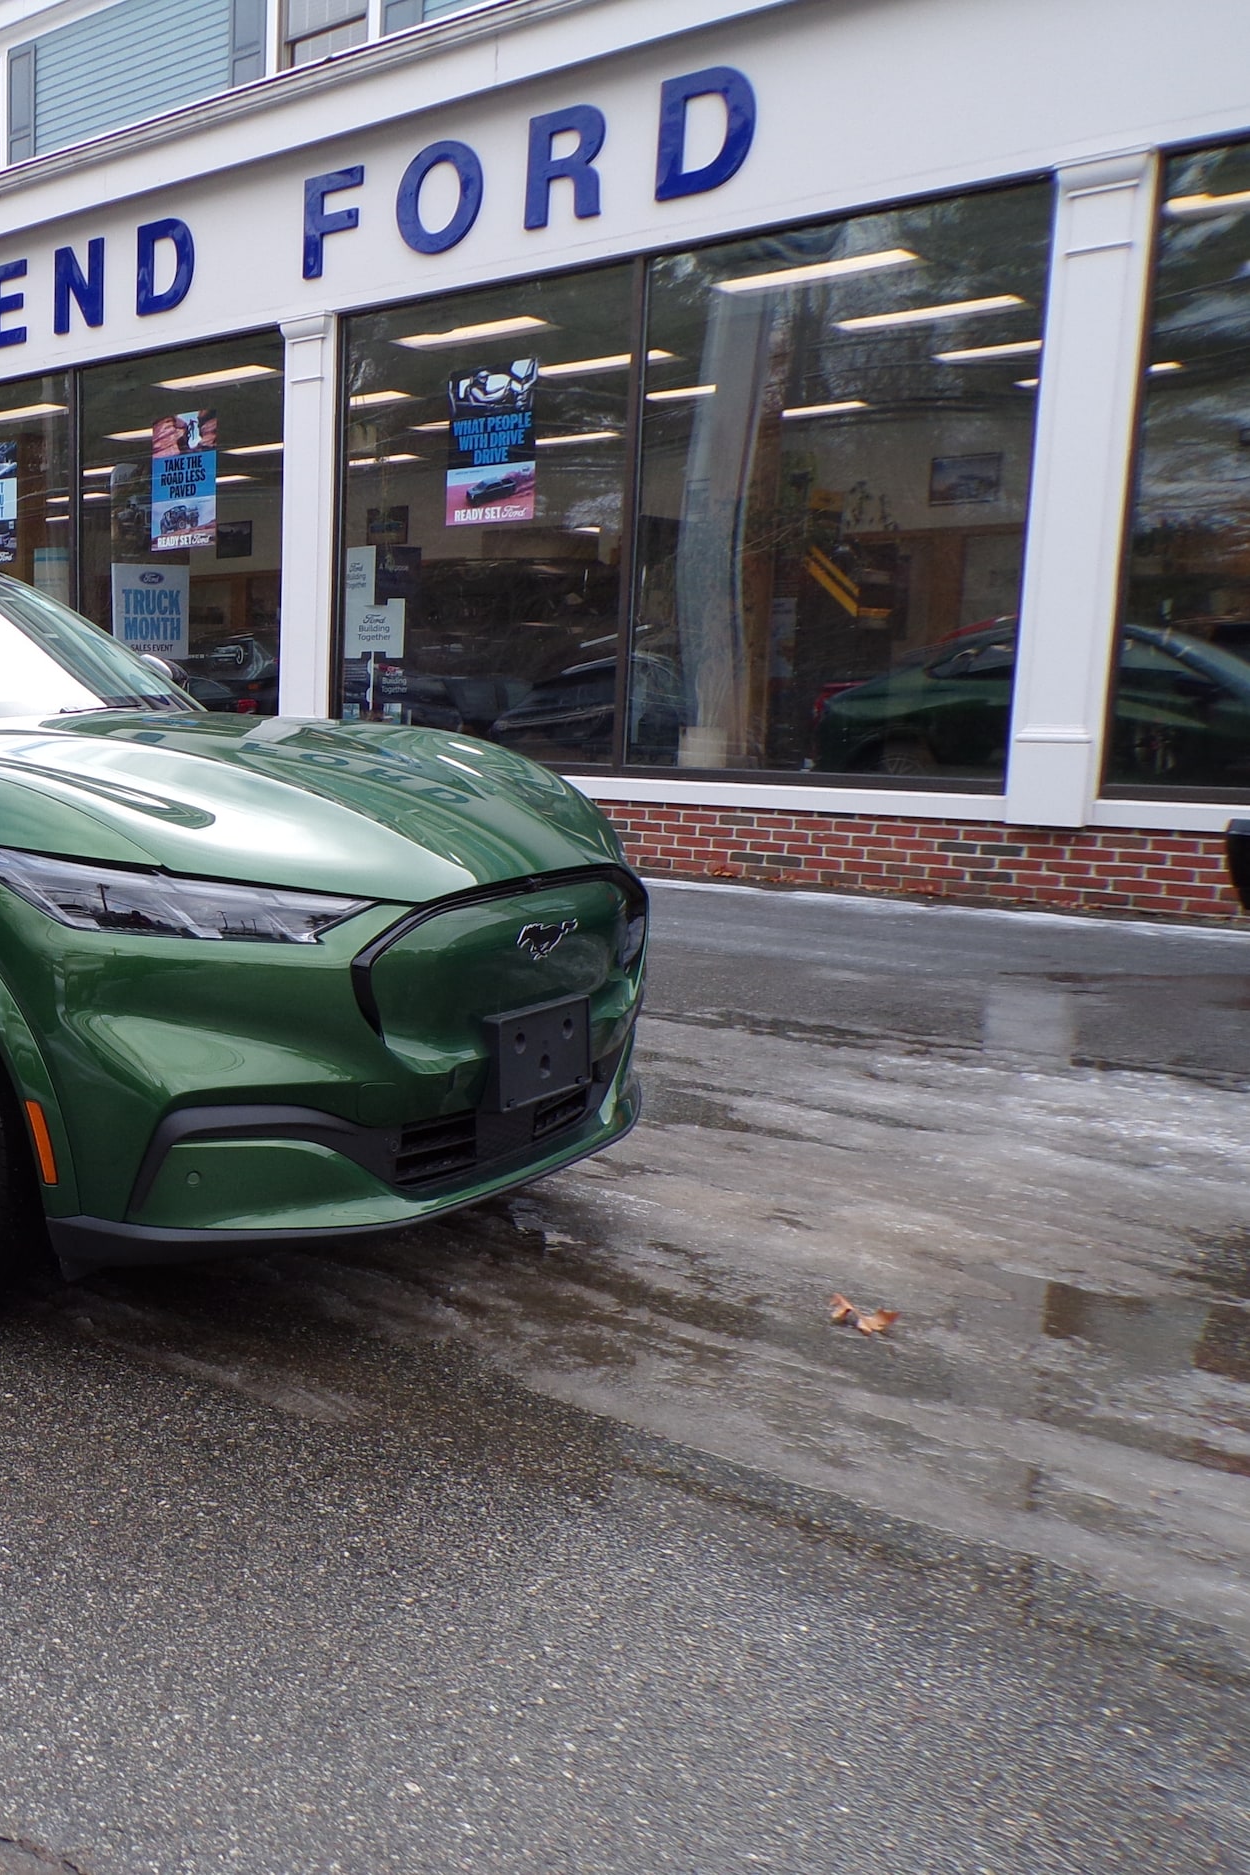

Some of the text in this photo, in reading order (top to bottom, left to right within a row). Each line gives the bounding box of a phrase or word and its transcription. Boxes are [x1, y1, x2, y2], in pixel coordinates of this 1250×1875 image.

[302, 65, 757, 279] FORD
[454, 412, 532, 436] WHAT PEOPLE
[459, 429, 525, 451] WITH DRIVE
[164, 455, 203, 473] TAKE THE
[474, 447, 508, 465] DRIVE
[161, 468, 206, 487] ROAD LESS
[169, 483, 196, 499] PAVED
[454, 505, 528, 522] READY SET Ford
[157, 533, 212, 548] READY SET Ford
[122, 588, 181, 615] TRUCK
[362, 614, 387, 624] Ford
[124, 616, 181, 640] MONTH
[358, 625, 390, 633] Building
[358, 633, 391, 642] Together
[131, 643, 174, 652] SALES EVENT
[381, 686, 408, 694] Together
[382, 677, 407, 686] Building
